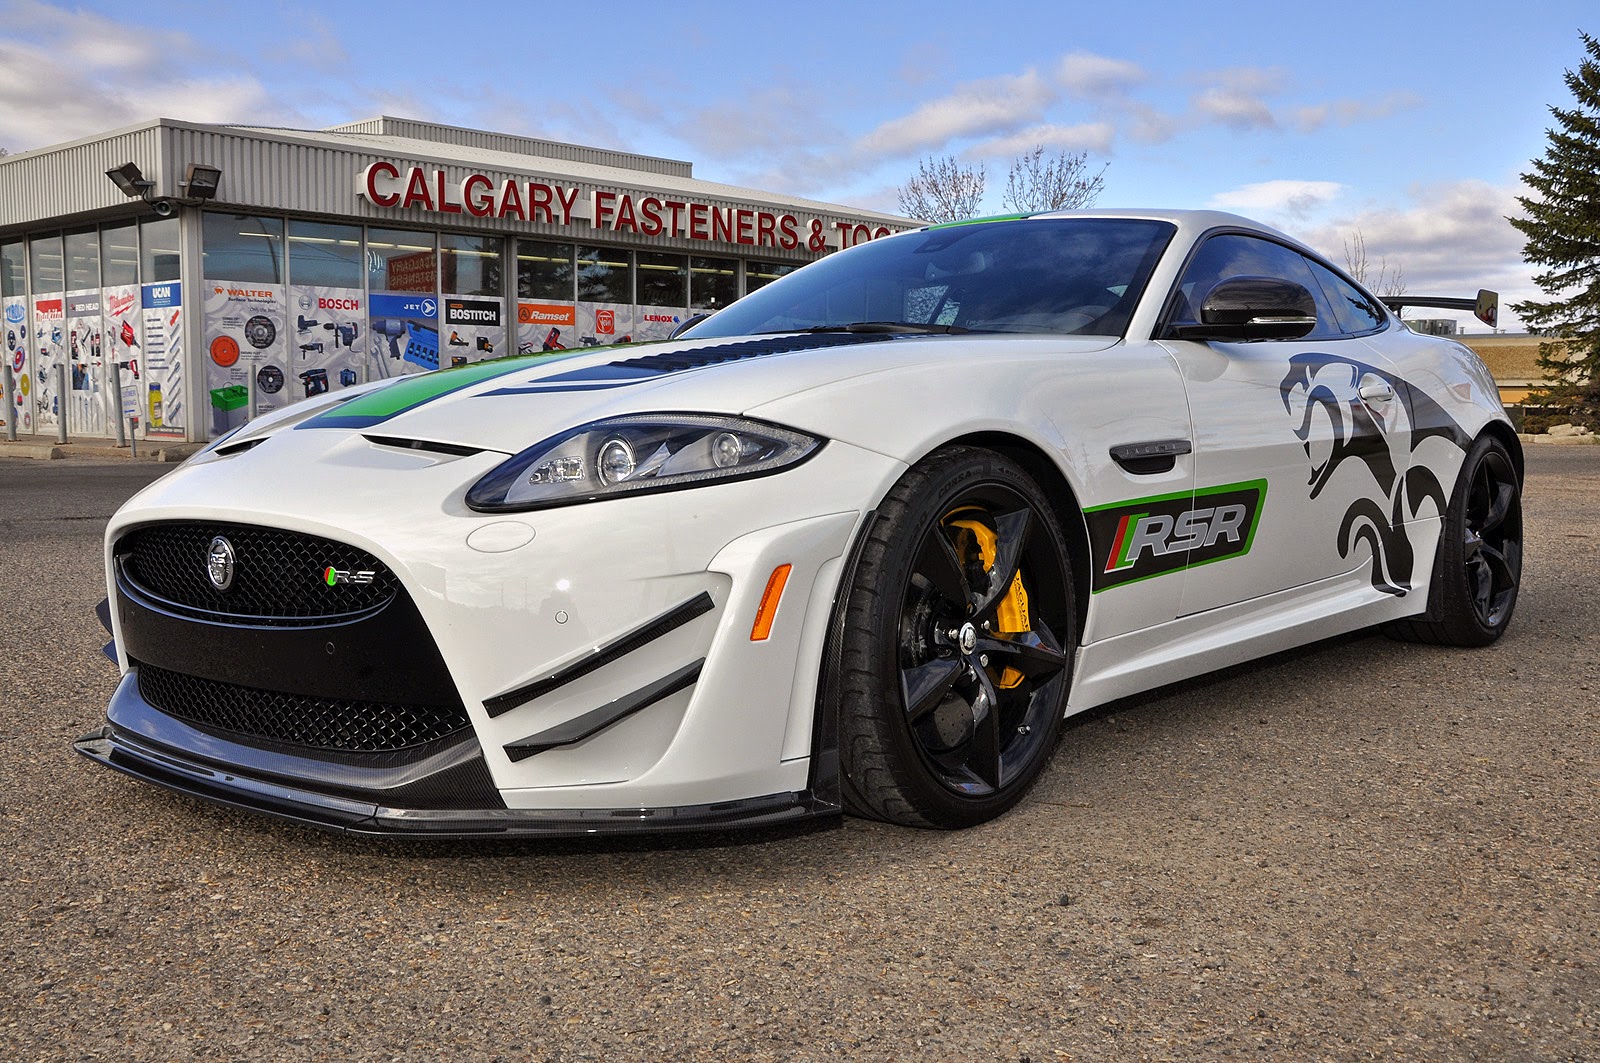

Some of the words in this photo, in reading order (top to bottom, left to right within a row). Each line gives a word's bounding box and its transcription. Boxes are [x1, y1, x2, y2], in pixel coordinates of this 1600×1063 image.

[364, 161, 579, 226] CALGARY
[593, 190, 799, 251] FASTENERS
[807, 218, 828, 253] &
[834, 222, 900, 251] TO
[152, 286, 171, 299] UCAN
[227, 288, 273, 298] WALTER
[247, 296, 276, 304] Technologies
[318, 297, 359, 311] BOSCH
[75, 304, 86, 312] RED
[86, 303, 99, 312] HEAD
[403, 303, 420, 311] JET
[449, 308, 496, 321] BOSTITCH
[530, 310, 571, 321] Ramset
[644, 314, 673, 323] LENOX
[1124, 503, 1247, 563] RSR
